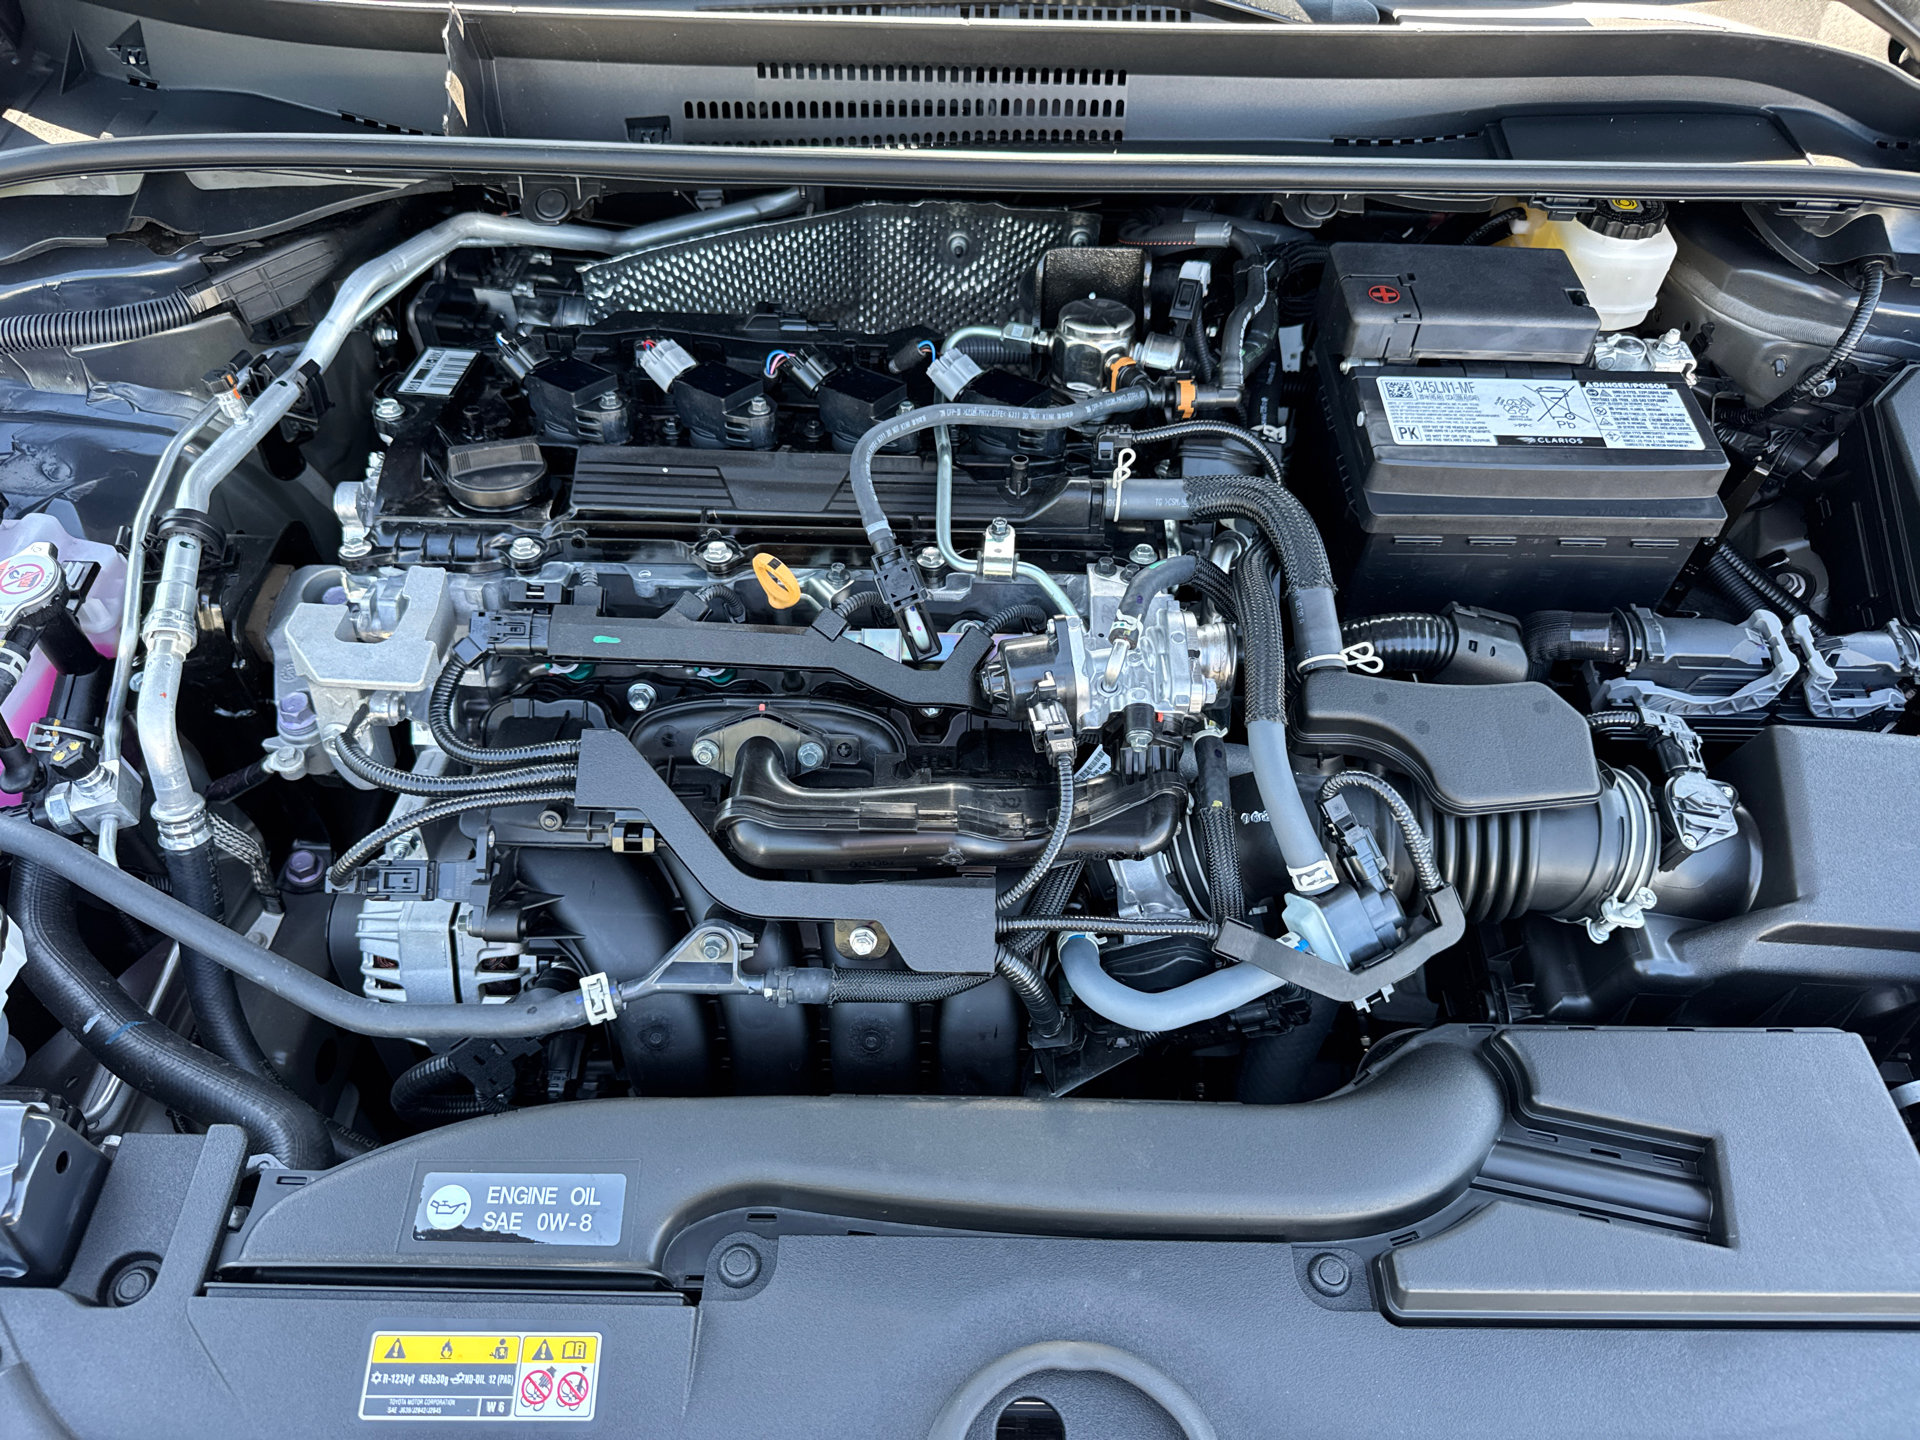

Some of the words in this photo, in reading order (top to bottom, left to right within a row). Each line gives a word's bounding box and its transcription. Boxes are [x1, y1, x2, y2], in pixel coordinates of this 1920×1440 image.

[1416, 381, 1476, 394] 345LN1-MF
[1556, 421, 1576, 429] Pb
[1398, 427, 1419, 440] PK
[487, 1186, 558, 1205] ENGINE
[570, 1187, 601, 1206] OIL
[482, 1211, 524, 1231] SAE
[537, 1212, 592, 1232] 0W-8
[382, 1373, 415, 1386] R-1234yf
[419, 1374, 449, 1386] 450±30g
[464, 1375, 485, 1384] ND-OIL
[489, 1375, 496, 1384] 12
[497, 1374, 514, 1386] (PAG)
[486, 1402, 497, 1413] W
[498, 1402, 505, 1413] 6
